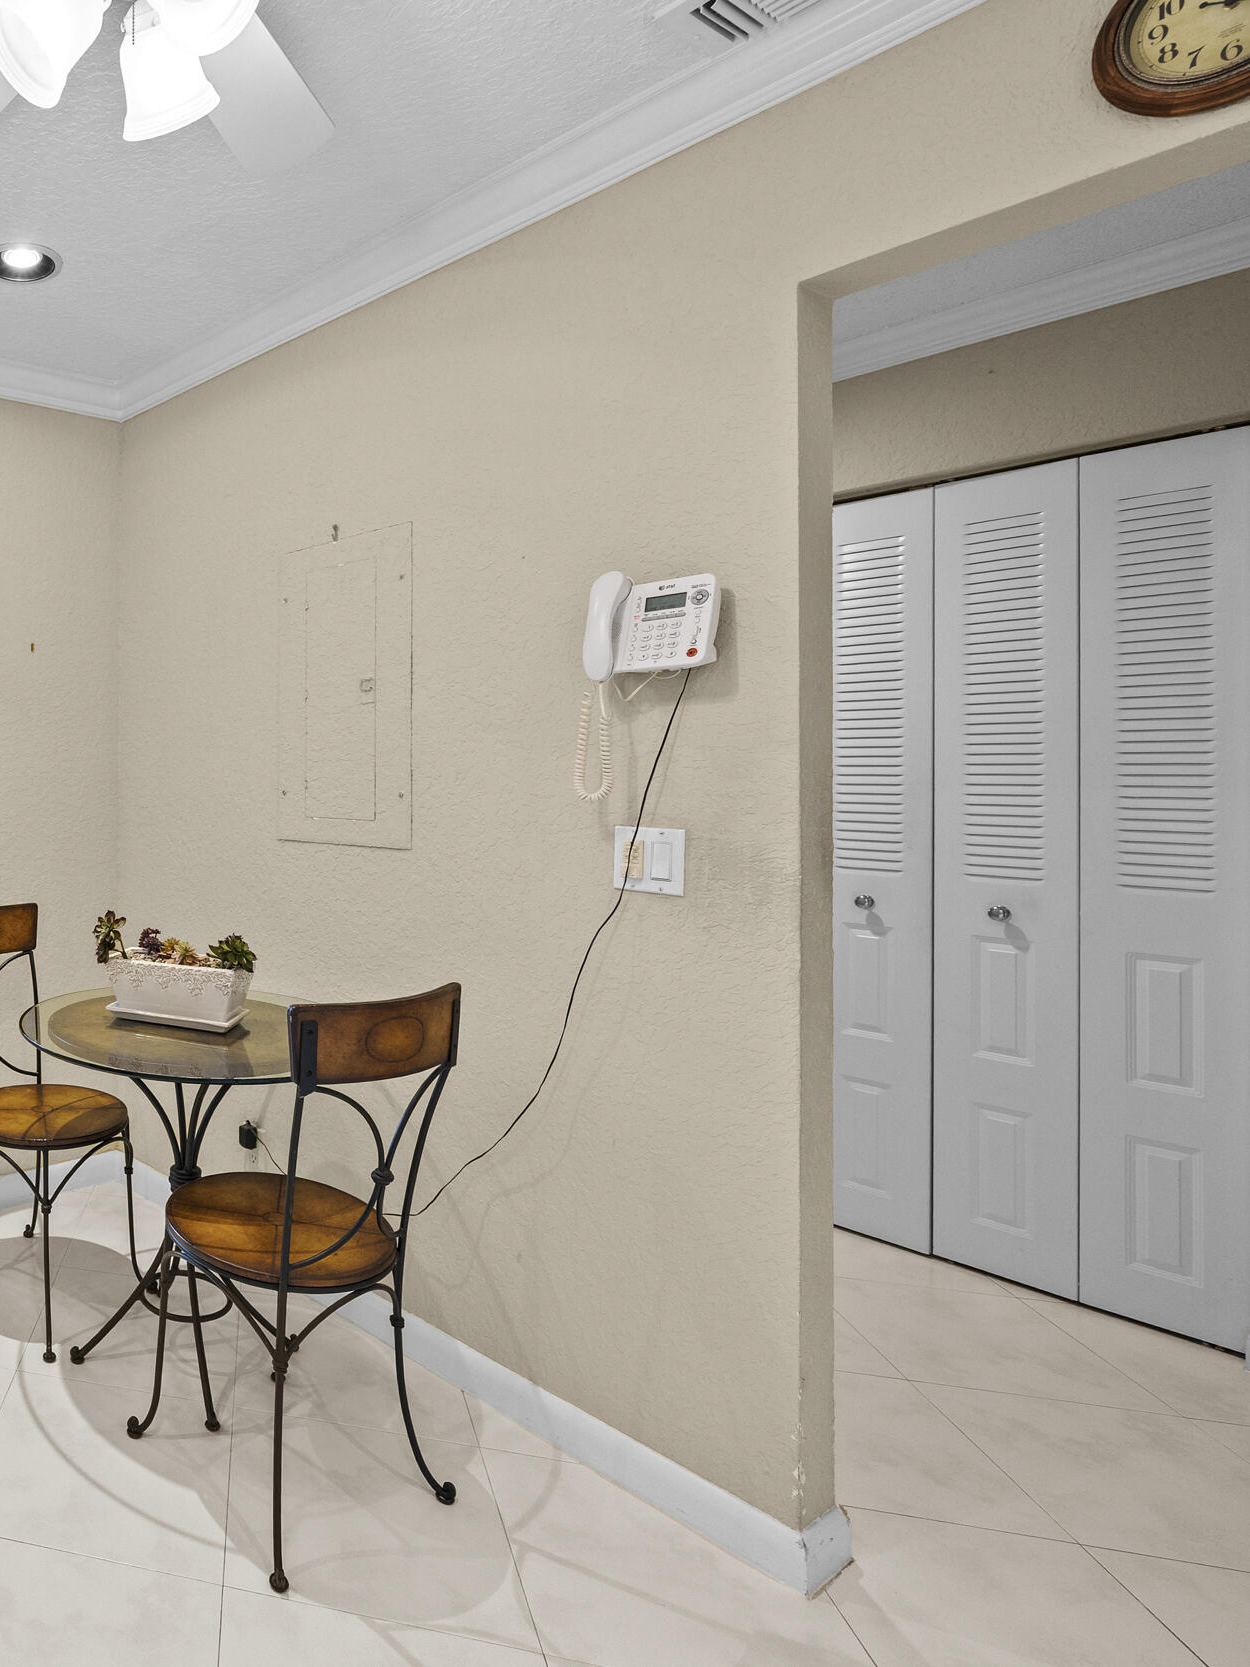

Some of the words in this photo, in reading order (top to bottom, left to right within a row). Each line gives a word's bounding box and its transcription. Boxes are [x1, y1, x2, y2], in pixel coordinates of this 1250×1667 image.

[1158, 0, 1185, 20] 10
[1148, 24, 1169, 45] 9
[1158, 43, 1179, 63] 8
[1187, 44, 1207, 69] 7
[1220, 39, 1243, 61] 6
